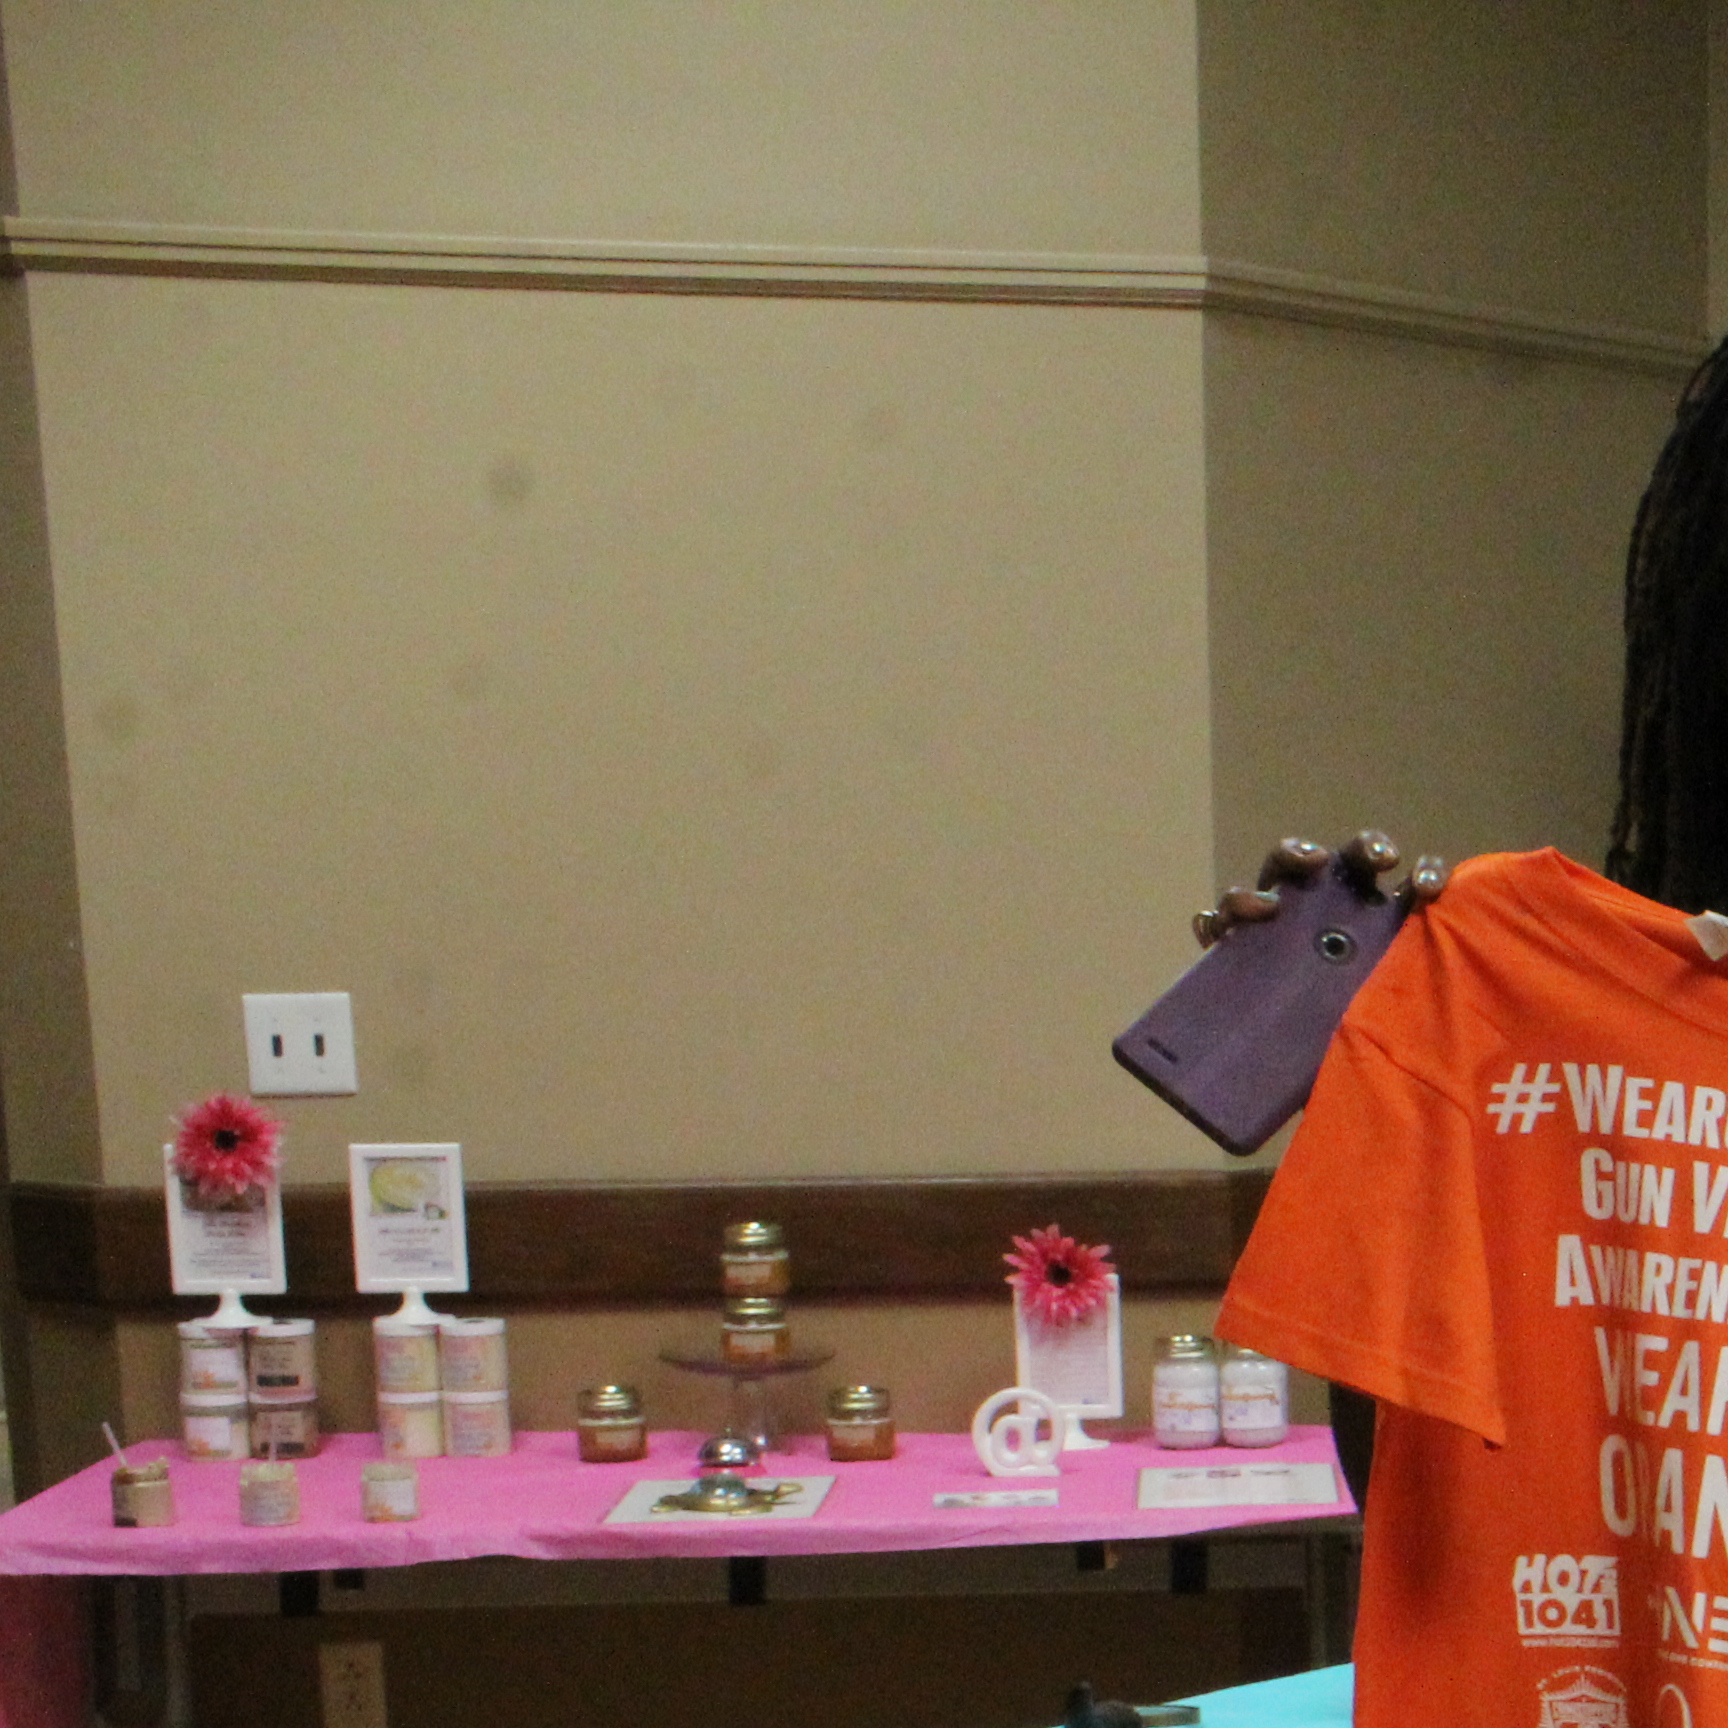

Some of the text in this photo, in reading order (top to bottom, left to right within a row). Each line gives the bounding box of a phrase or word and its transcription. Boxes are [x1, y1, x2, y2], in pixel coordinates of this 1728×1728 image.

[1579, 1148, 1675, 1228] GUN
[1513, 1553, 1619, 1595] HOT
[1519, 1598, 1617, 1631] 1041
